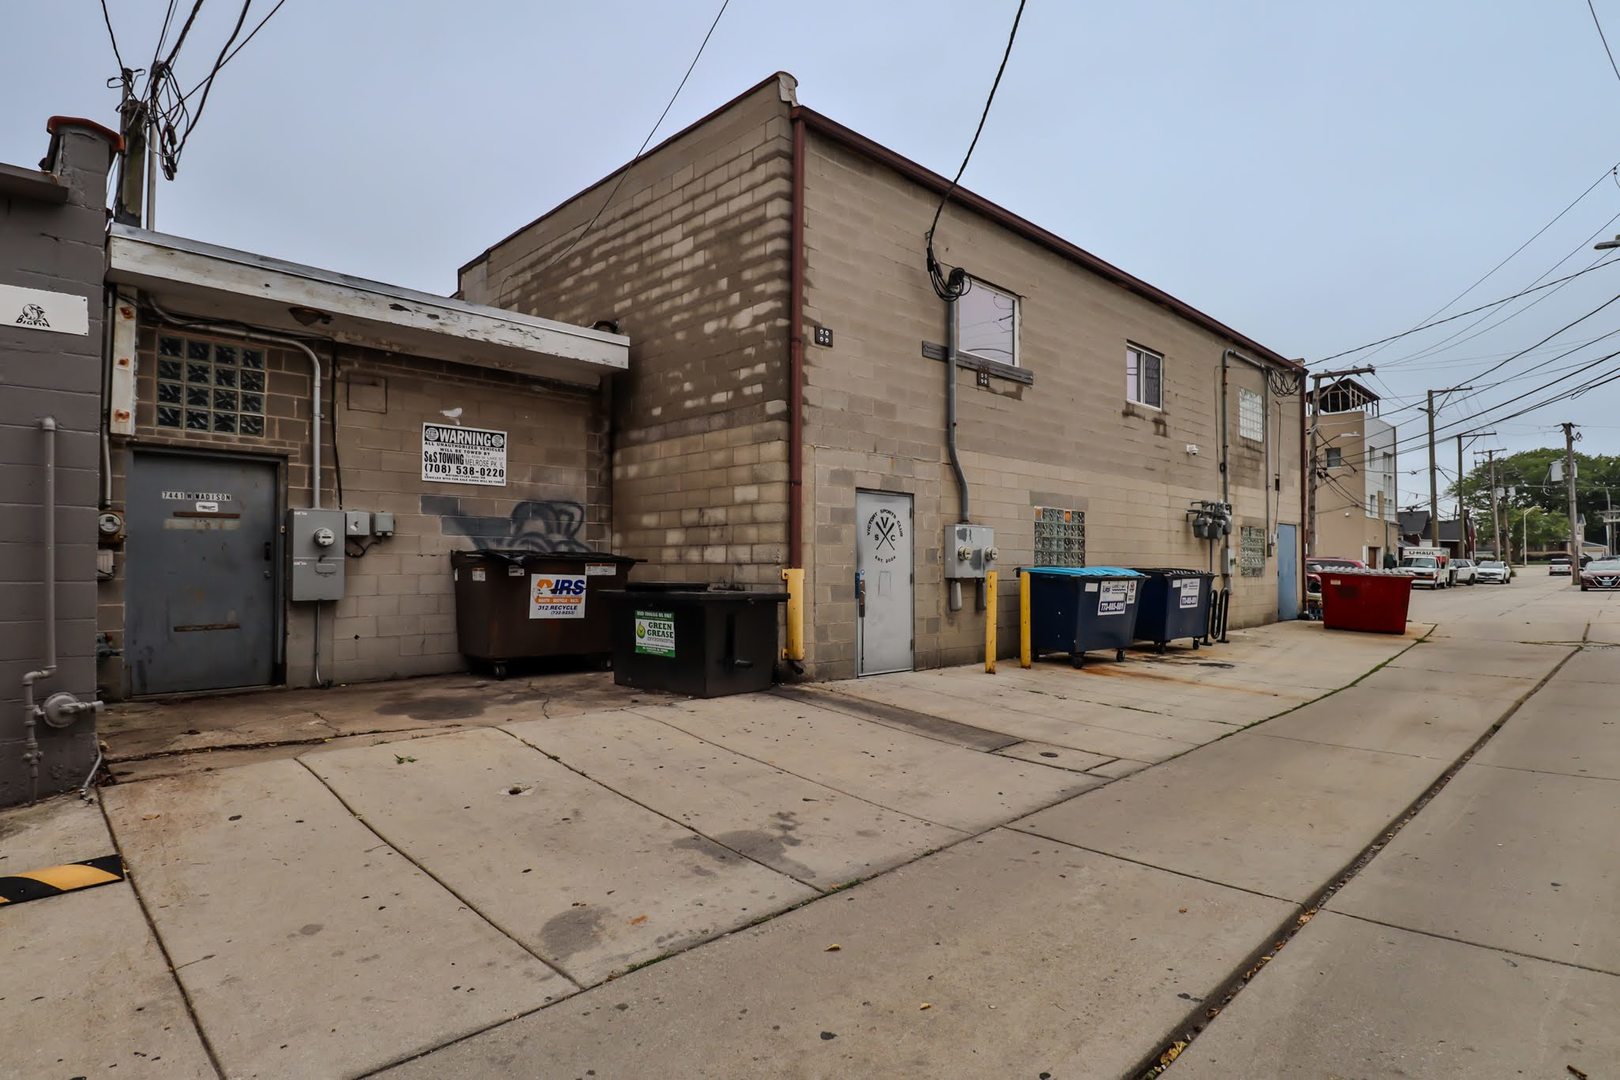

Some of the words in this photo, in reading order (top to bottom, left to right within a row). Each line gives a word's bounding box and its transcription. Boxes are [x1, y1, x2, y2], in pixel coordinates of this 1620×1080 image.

[439, 428, 491, 447] WARNING
[436, 442, 478, 450] UNAUTHORIZED
[424, 450, 438, 463] S&S
[439, 452, 464, 465] TOWING
[465, 458, 489, 468] MELROSE
[424, 464, 451, 474] (708)
[456, 466, 504, 478] 538-0220
[162, 492, 184, 500] 7441
[195, 492, 231, 500] MADISON
[880, 516, 889, 528] V
[648, 622, 672, 630] GREEN
[647, 629, 674, 638] GREASE
